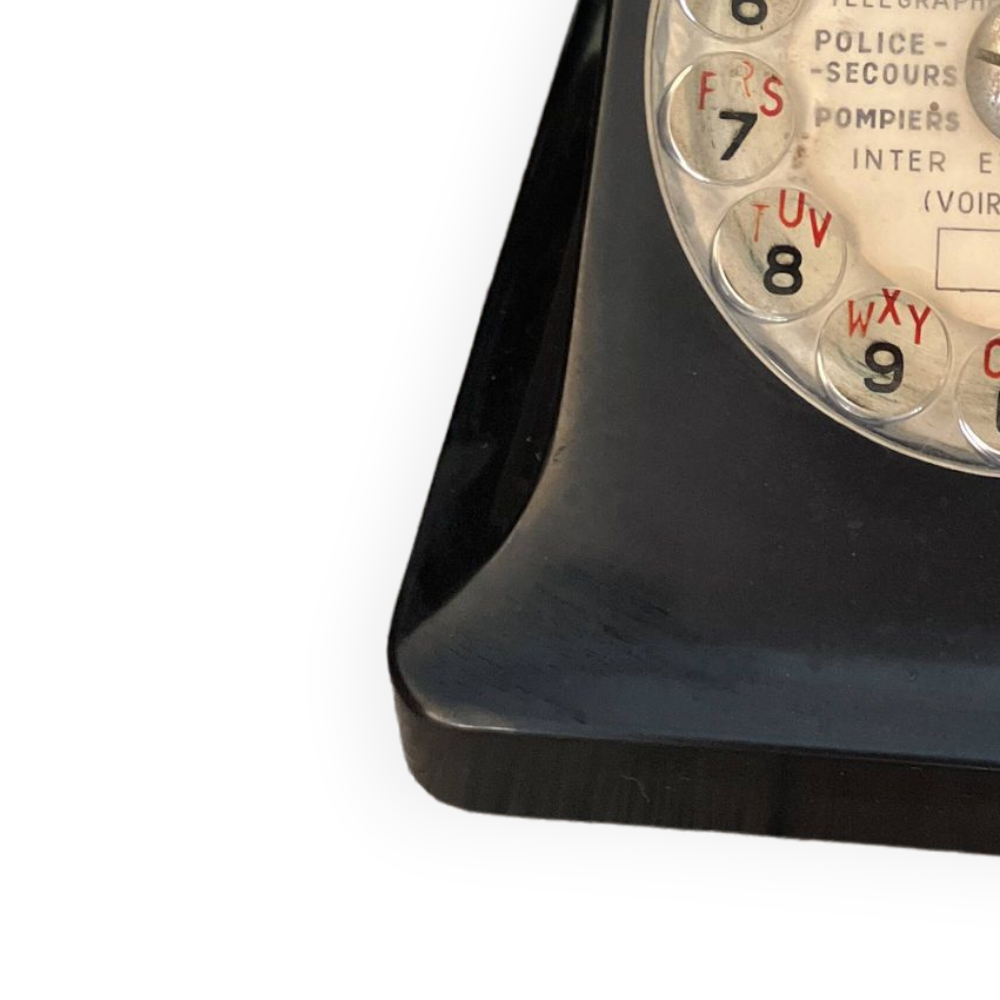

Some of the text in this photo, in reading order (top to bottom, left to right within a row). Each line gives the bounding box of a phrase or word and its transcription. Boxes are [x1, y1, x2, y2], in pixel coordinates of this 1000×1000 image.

[718, 110, 758, 161] 7
[814, 106, 960, 133] POMPIERS
[852, 148, 947, 173] INTER
[763, 244, 803, 296] 8
[863, 341, 904, 394] 9
